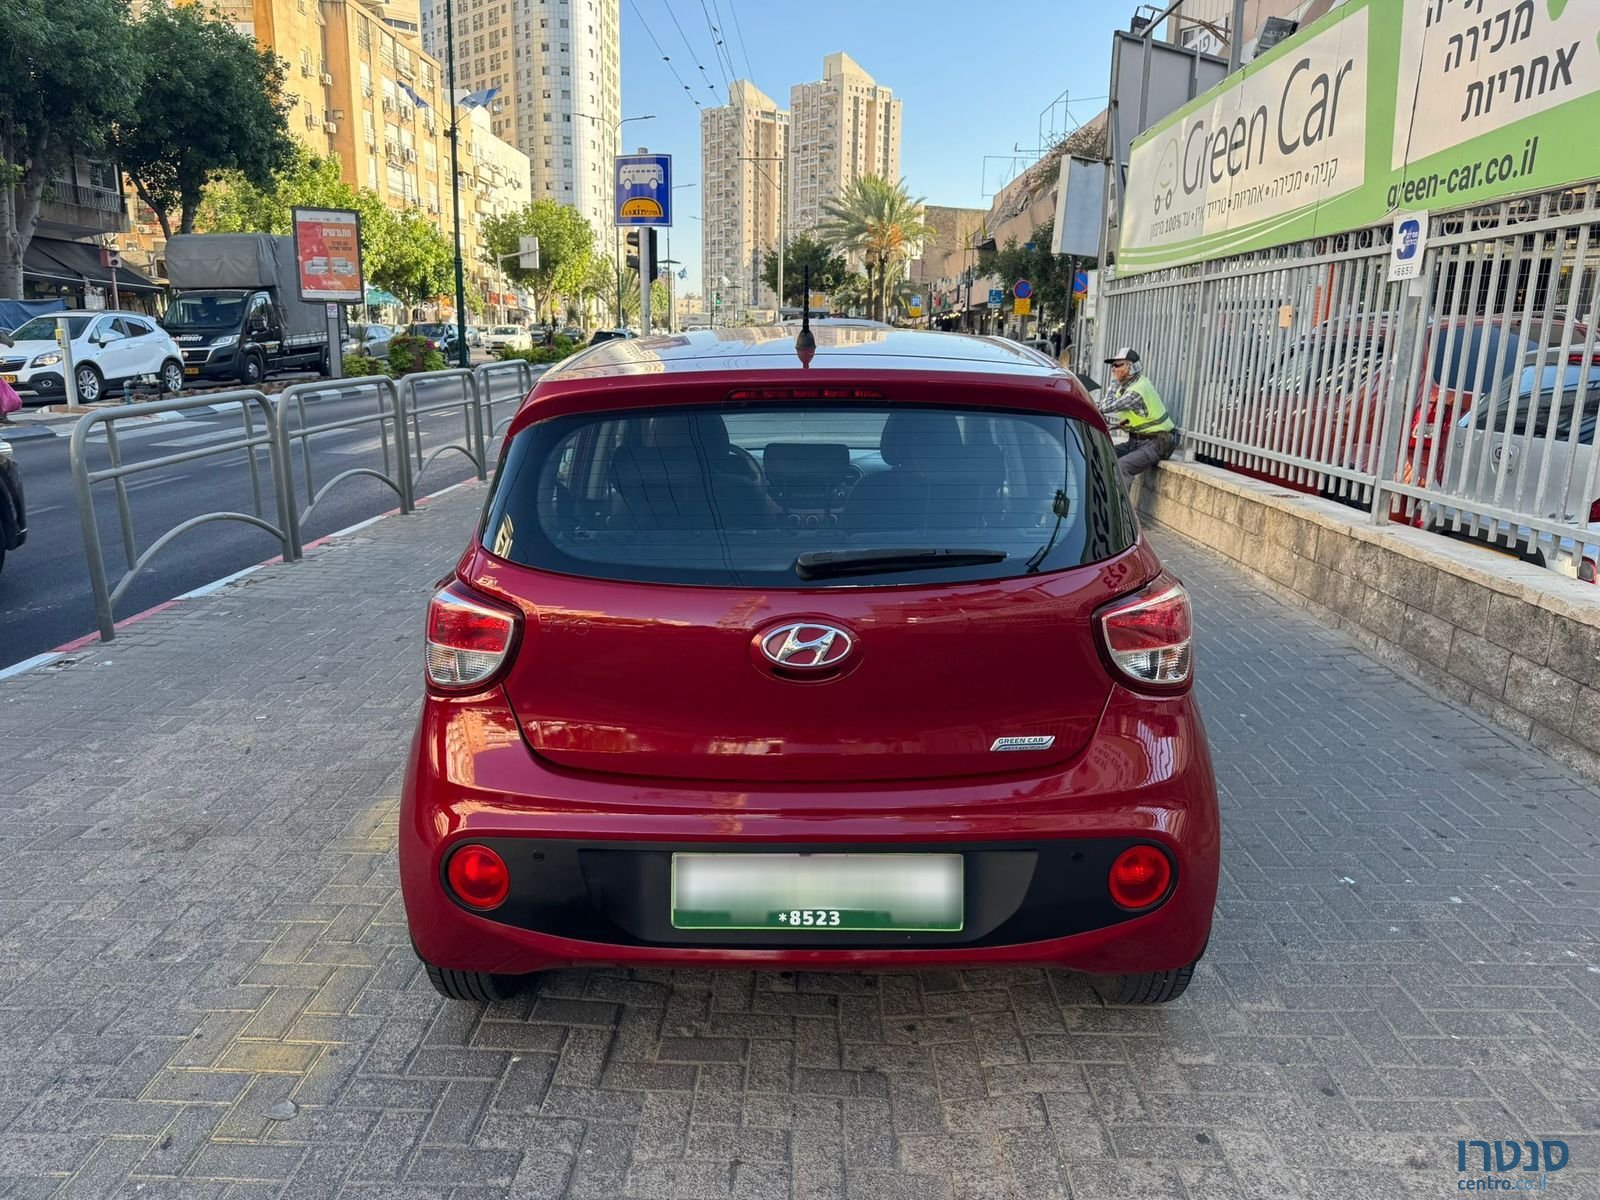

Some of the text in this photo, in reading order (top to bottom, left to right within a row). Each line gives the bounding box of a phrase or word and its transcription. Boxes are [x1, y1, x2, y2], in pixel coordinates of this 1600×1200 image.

[1444, 0, 1535, 73] מכירה
[1461, 41, 1580, 122] אחריות
[1182, 58, 1354, 195] Green Car
[1232, 184, 1264, 211] אחריות
[1271, 170, 1302, 198] מכירה
[1311, 158, 1339, 187] קניה
[1386, 136, 1539, 212] green-car.co.il
[1165, 213, 1182, 233] 100%
